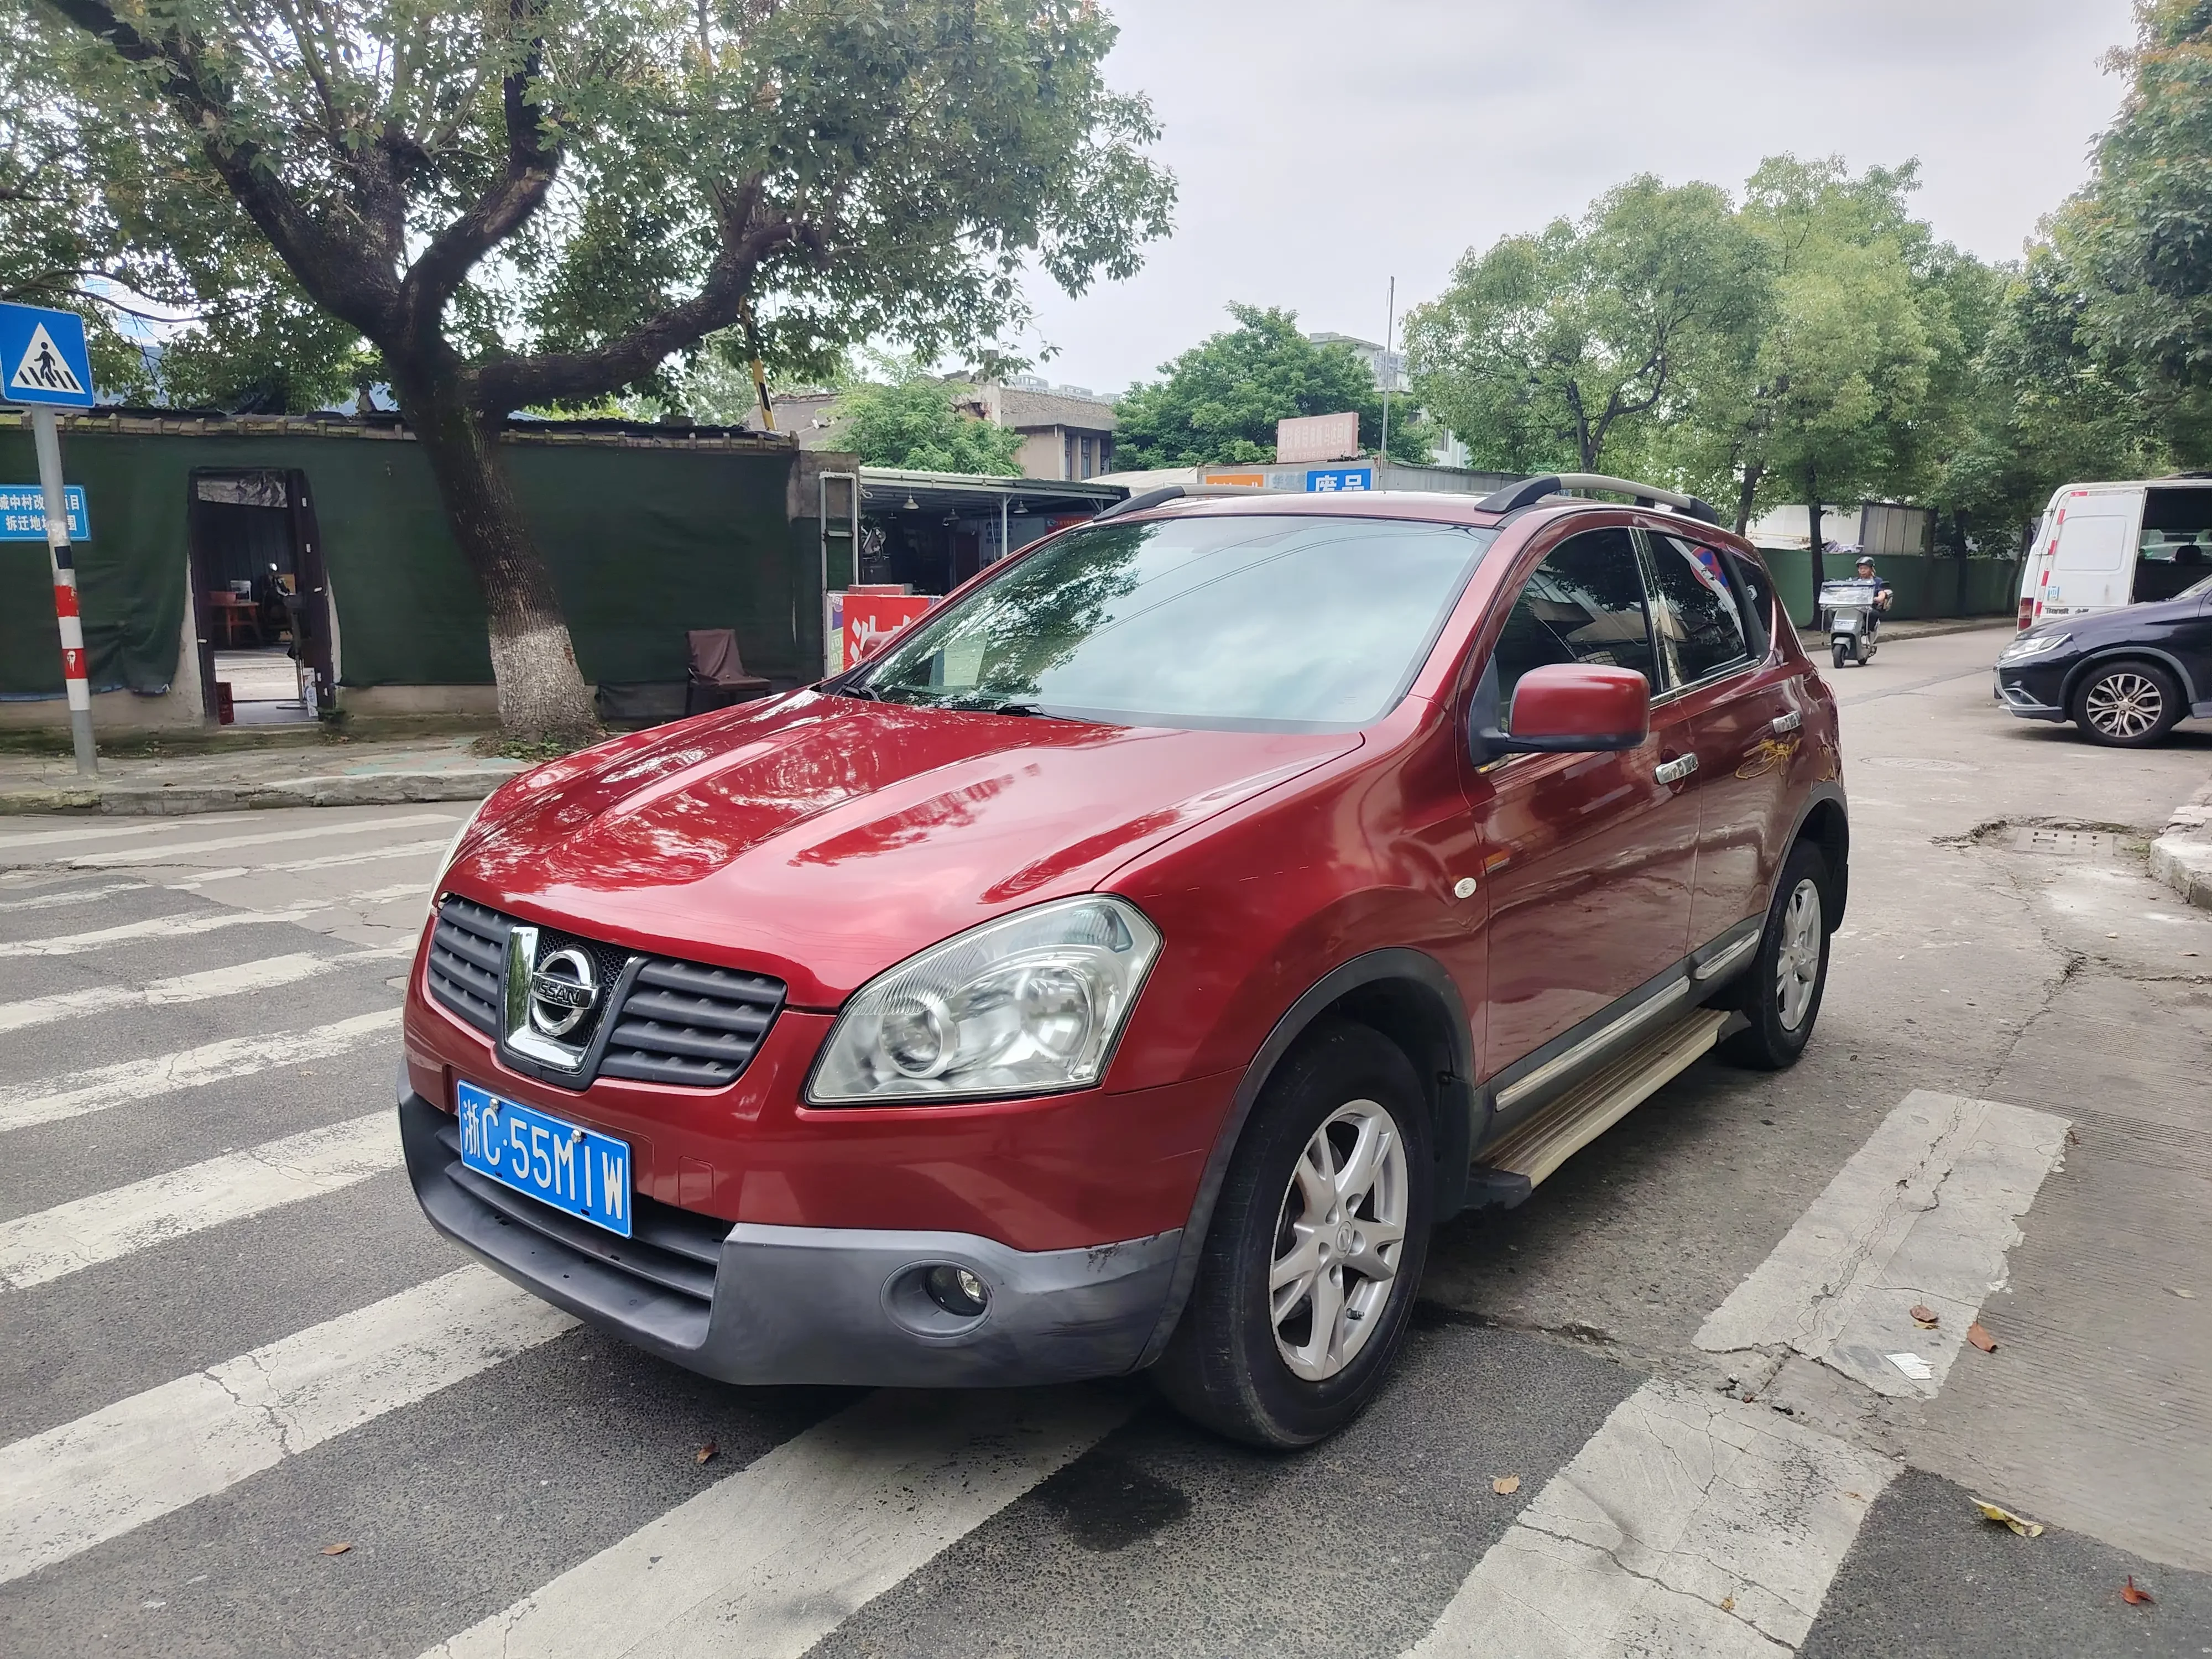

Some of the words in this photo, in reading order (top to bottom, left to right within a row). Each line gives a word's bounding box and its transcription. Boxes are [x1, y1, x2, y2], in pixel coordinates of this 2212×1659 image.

[0, 494, 80, 510] 城中村改目
[6, 515, 77, 531] 拆迁地围
[532, 978, 580, 1005] NISSAN
